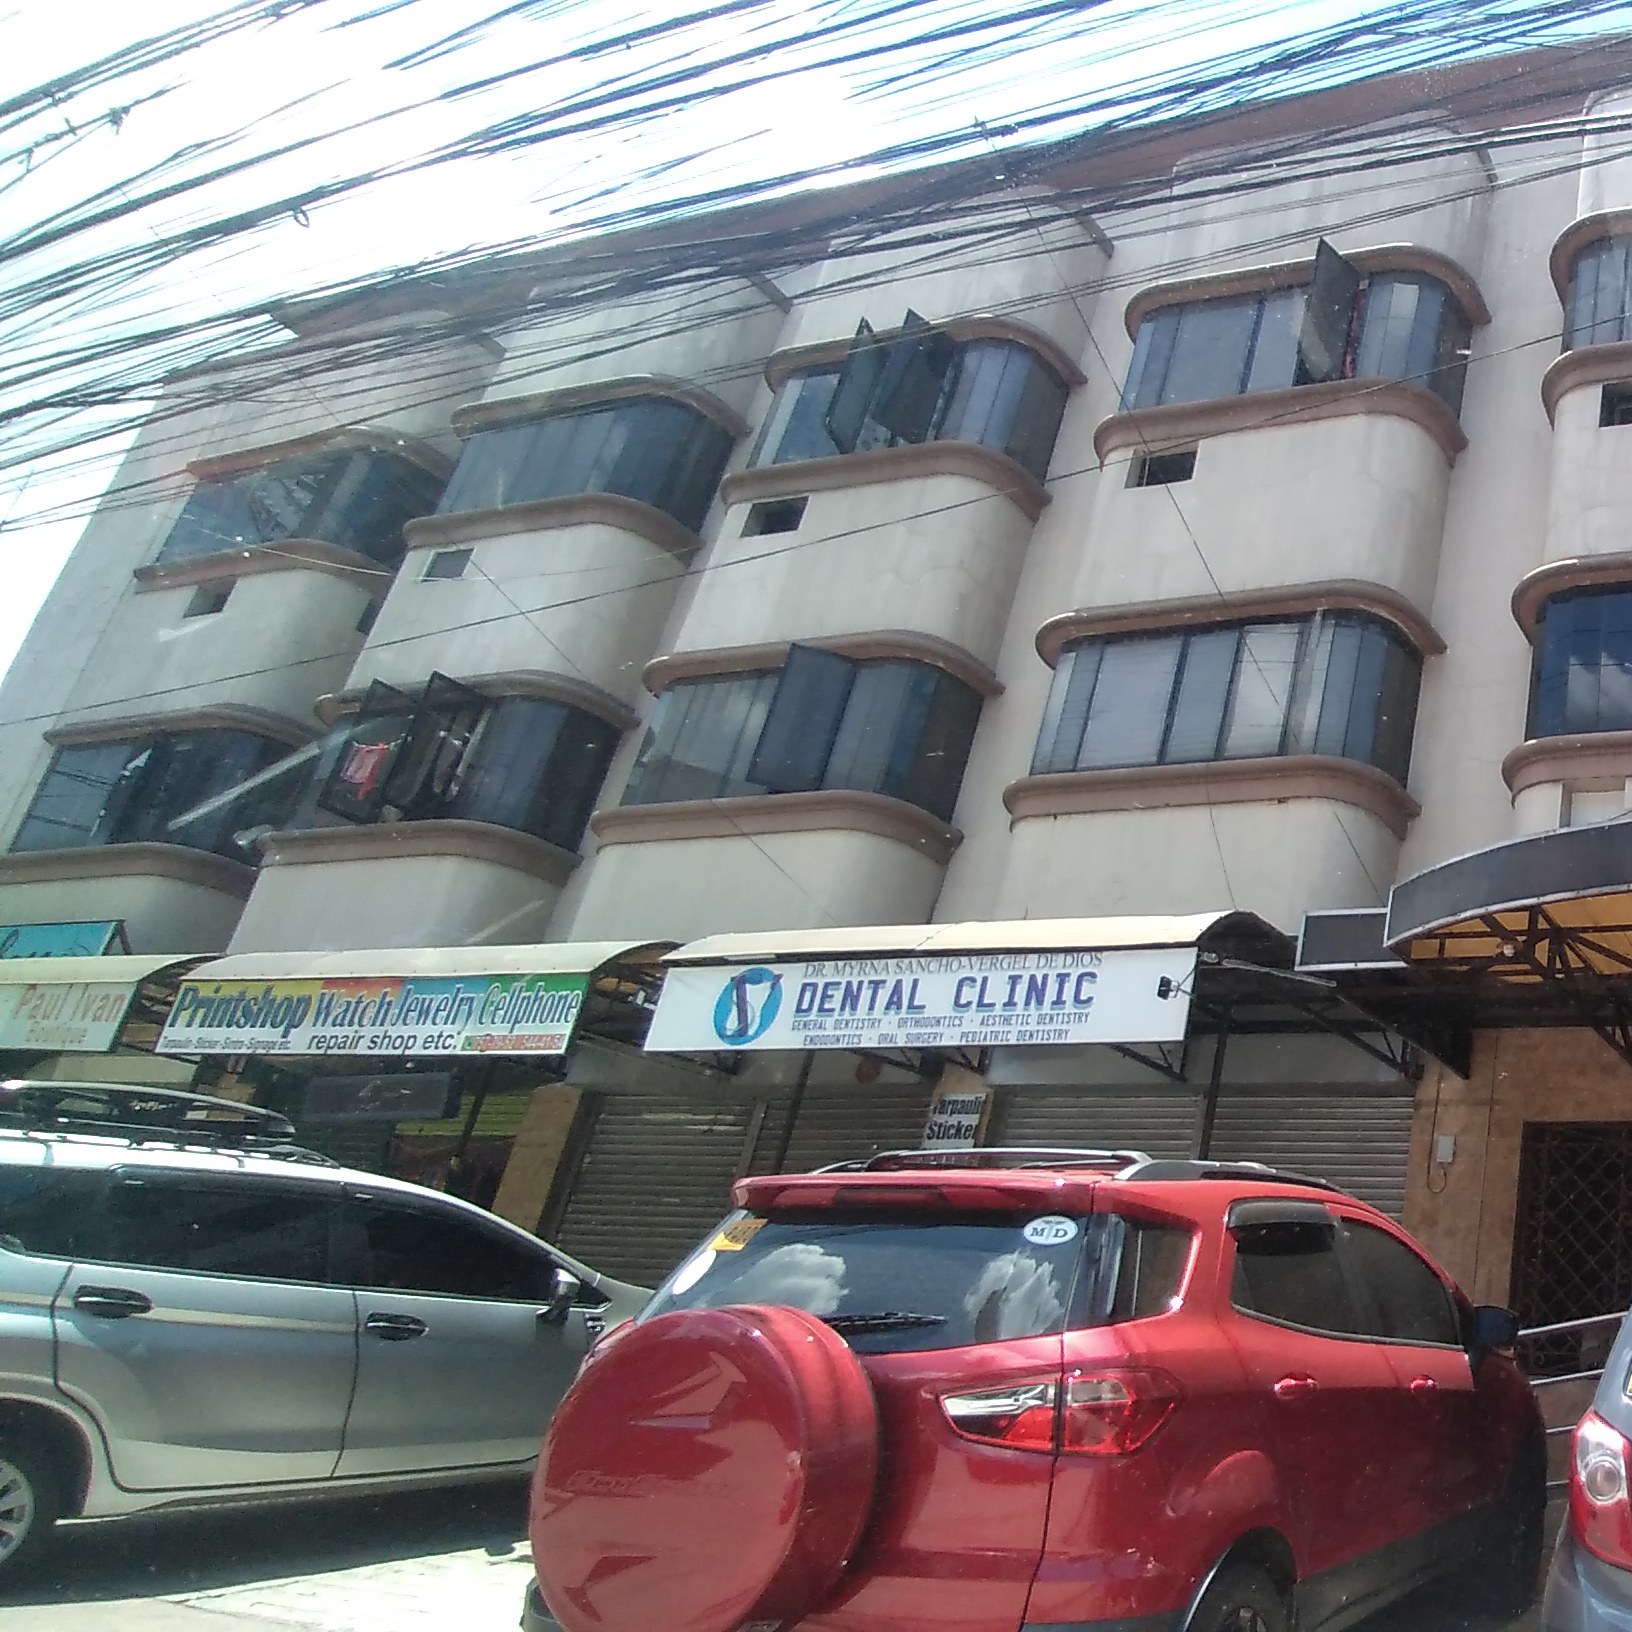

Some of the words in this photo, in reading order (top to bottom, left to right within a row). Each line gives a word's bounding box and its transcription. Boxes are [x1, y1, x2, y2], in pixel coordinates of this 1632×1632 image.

[803, 963, 828, 978] DR.
[832, 959, 891, 977] MYRNA
[893, 955, 1036, 976] SANCHO-VERGEL
[1036, 953, 1058, 969] DE
[1062, 951, 1103, 968] DIOS
[12, 983, 74, 1021] Paul
[70, 983, 127, 1022] Ivan
[793, 977, 926, 1017] DENTAL
[953, 971, 1099, 1013] CLINIC
[168, 984, 312, 1039] Printshop
[312, 988, 395, 1029] Watch
[391, 984, 476, 1035] Jewelry
[478, 982, 582, 1035] Cellphone
[792, 1017, 828, 1031] GENERAL
[833, 1016, 882, 1030] DENTISTRY
[897, 1015, 965, 1029] ORTHODONTICS
[979, 1013, 1032, 1027] AESTHETIC
[1036, 1011, 1091, 1026] DENTISTRY
[306, 1030, 366, 1054] repair
[366, 1029, 418, 1055] shop
[422, 1030, 458, 1051] etc.
[803, 1033, 863, 1046] ENDODONTICS
[877, 1033, 900, 1045] ORAL
[904, 1032, 944, 1045] SURGERY
[959, 1030, 1011, 1043] PEDIATRIC
[1016, 1028, 1071, 1042] DENTISTRY
